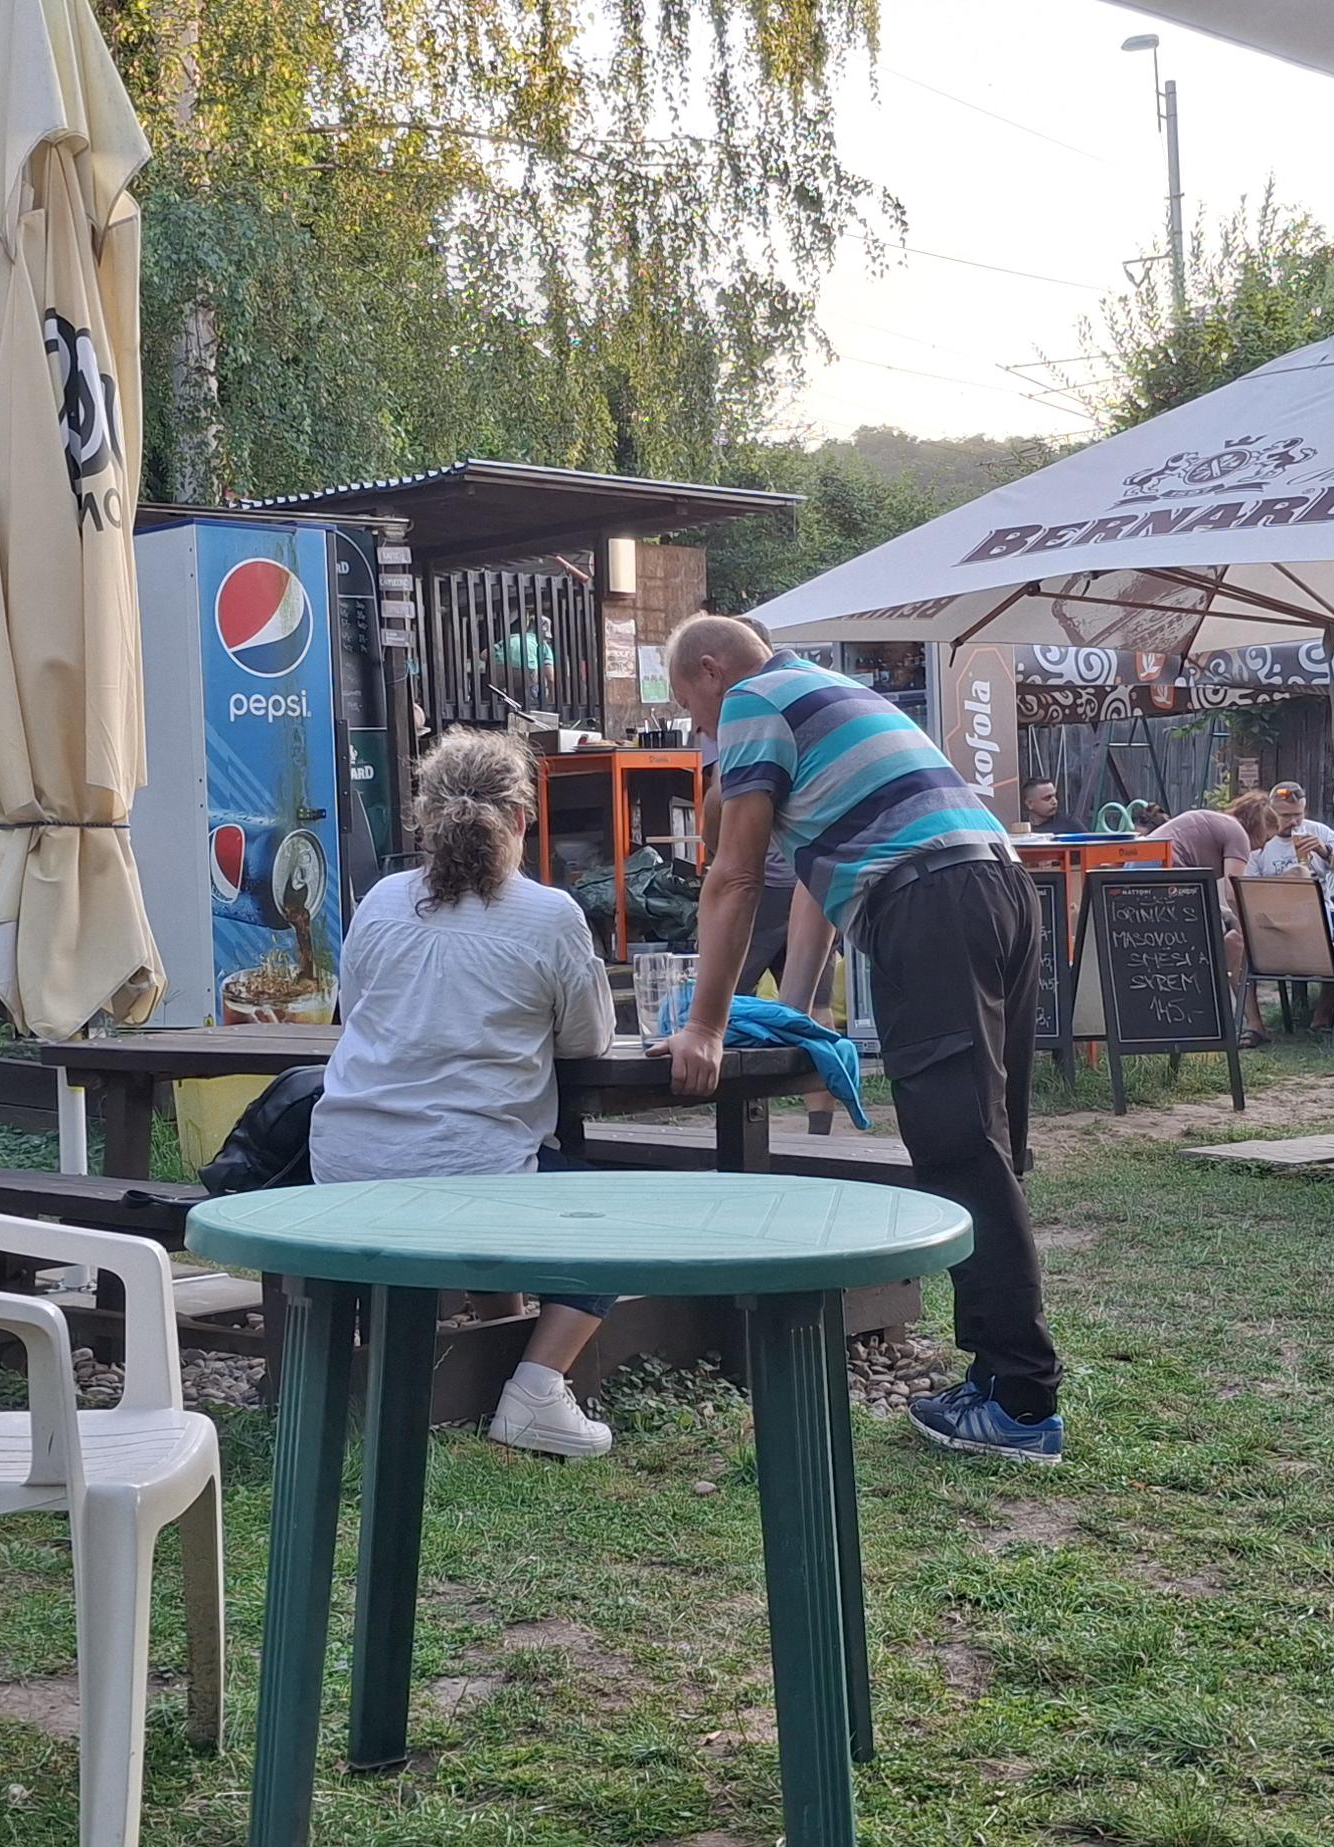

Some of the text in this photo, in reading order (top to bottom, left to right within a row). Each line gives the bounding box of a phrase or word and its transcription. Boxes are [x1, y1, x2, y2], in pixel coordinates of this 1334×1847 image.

[229, 690, 308, 723] pepsi
[965, 679, 1002, 799] kofola
[1182, 906, 1198, 922] S
[1112, 930, 1188, 949] MASOVOU
